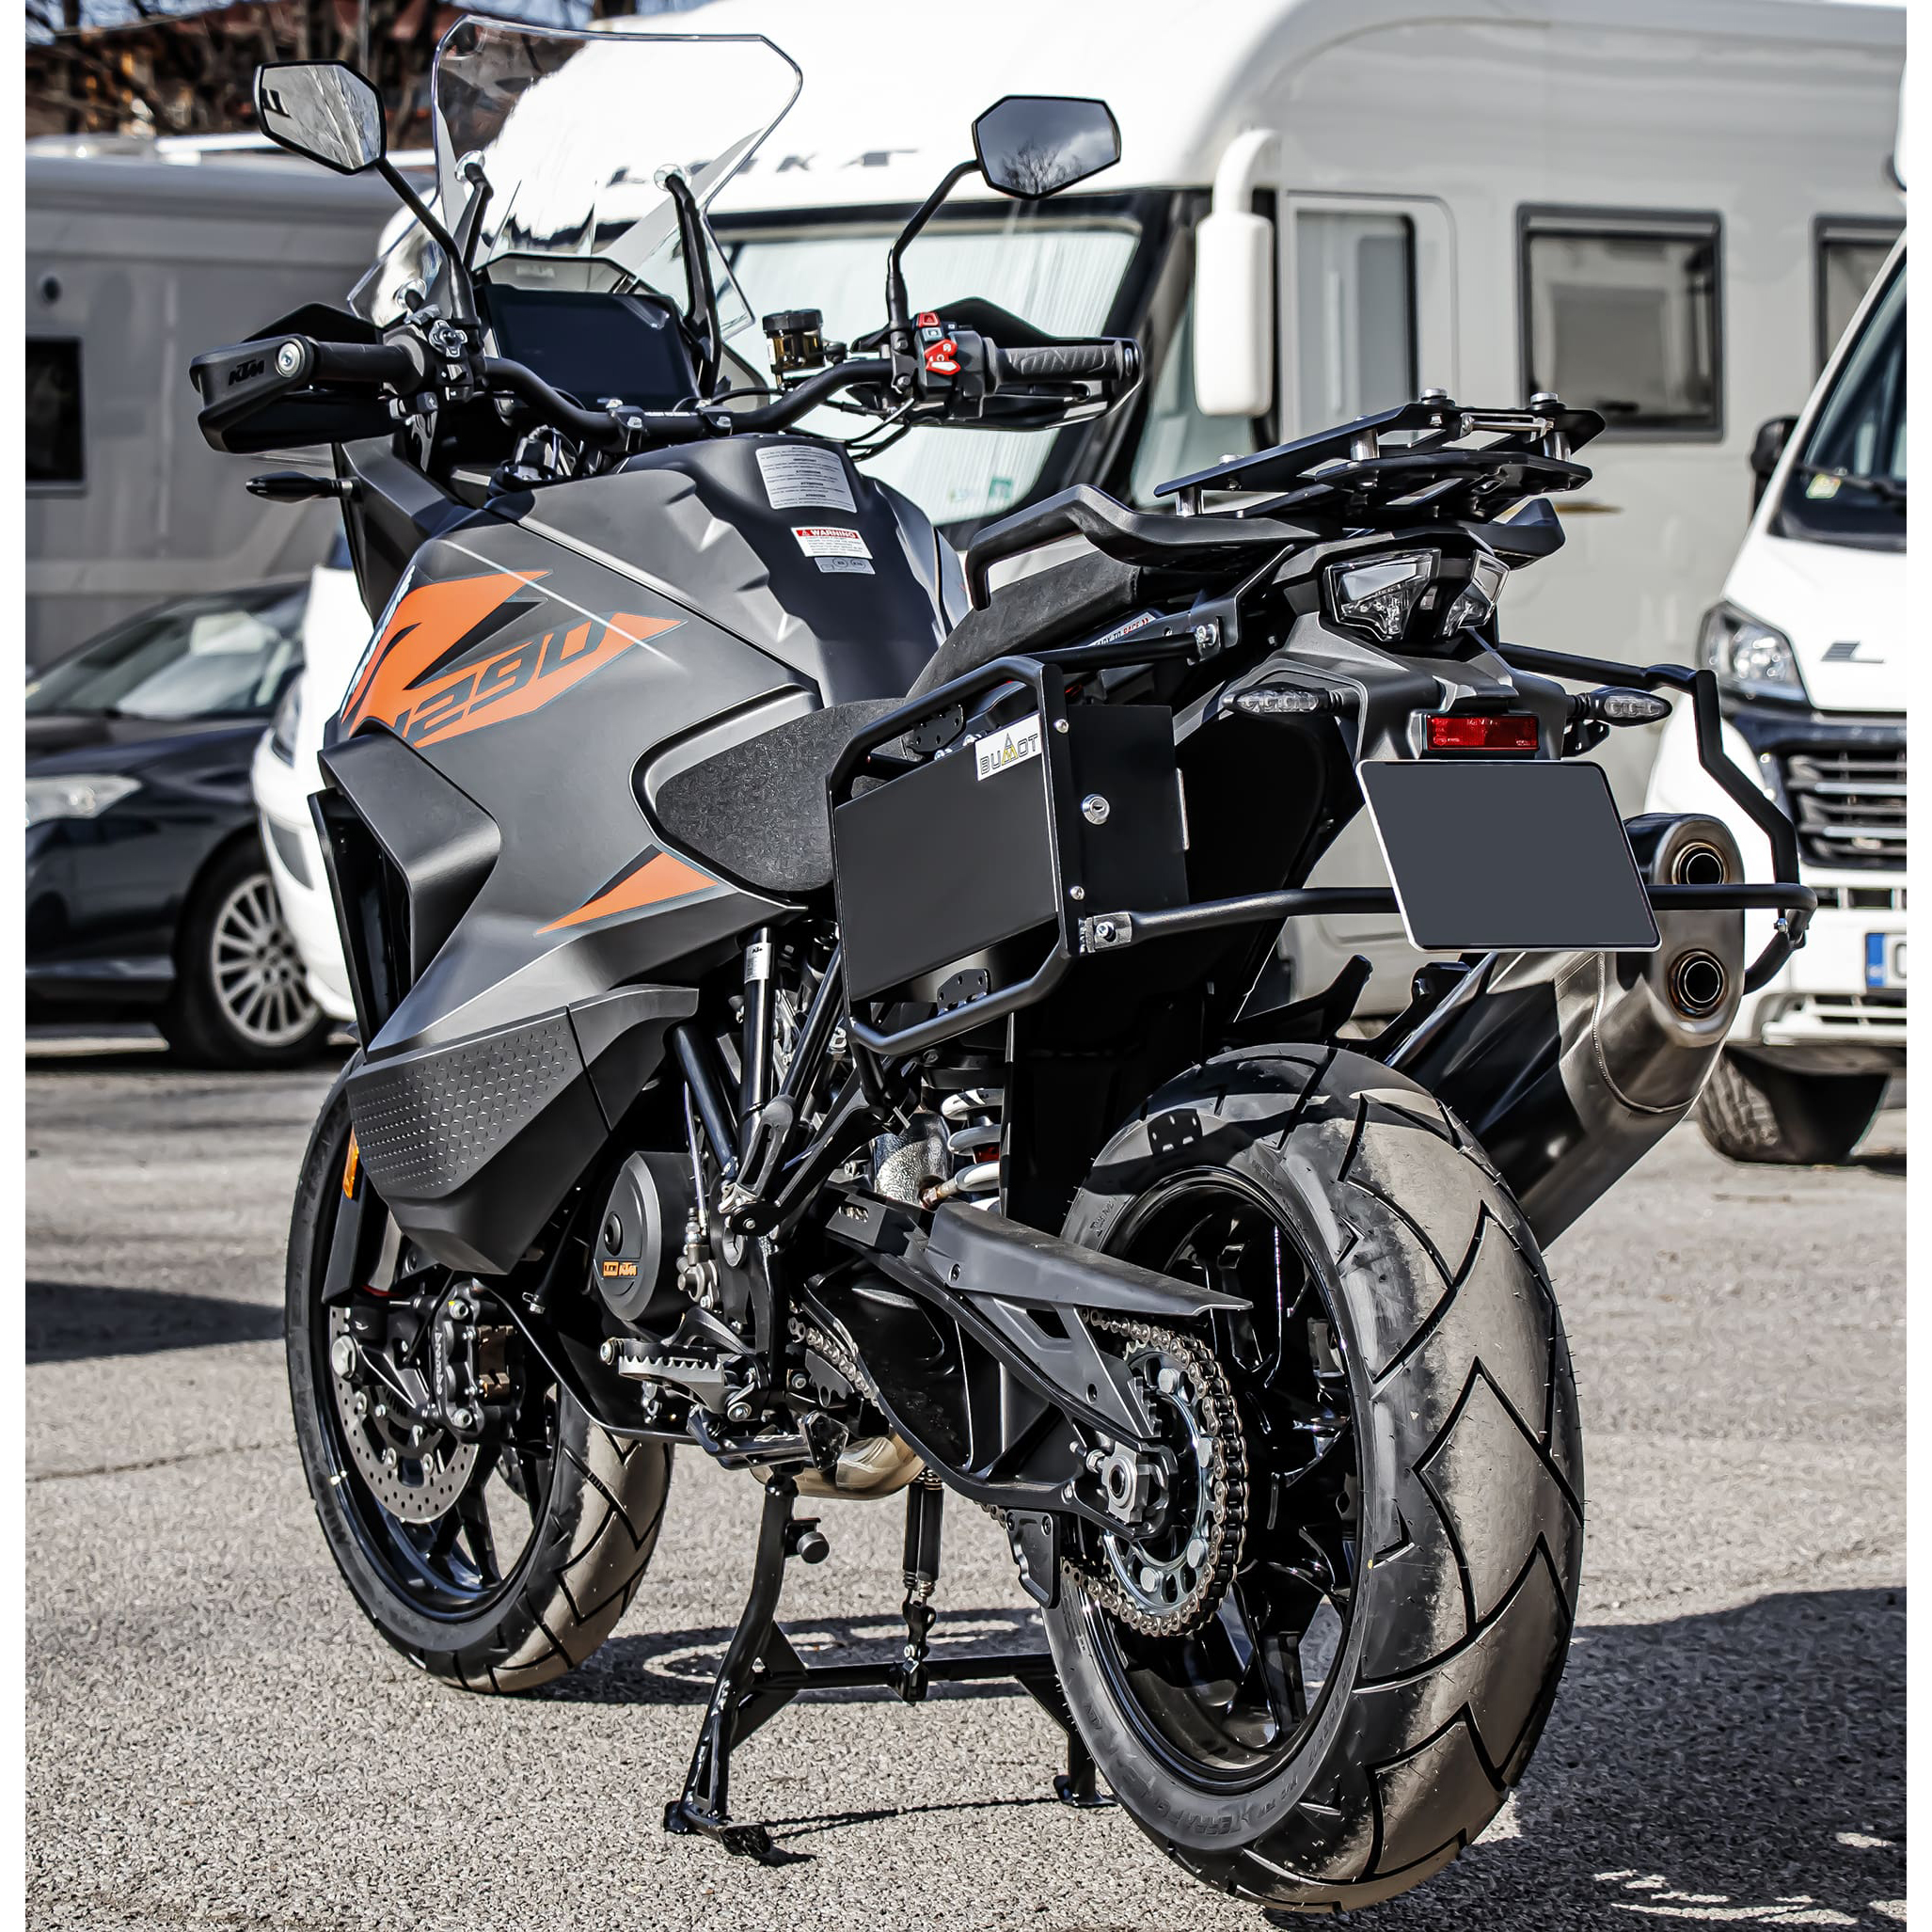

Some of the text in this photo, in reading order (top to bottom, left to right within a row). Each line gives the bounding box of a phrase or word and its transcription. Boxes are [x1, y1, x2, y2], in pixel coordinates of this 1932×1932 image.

[229, 359, 264, 386] KTM
[811, 529, 855, 538] WARNING
[393, 617, 609, 741] 1290
[980, 732, 1038, 775] BUMOT
[435, 1332, 444, 1395] brembo
